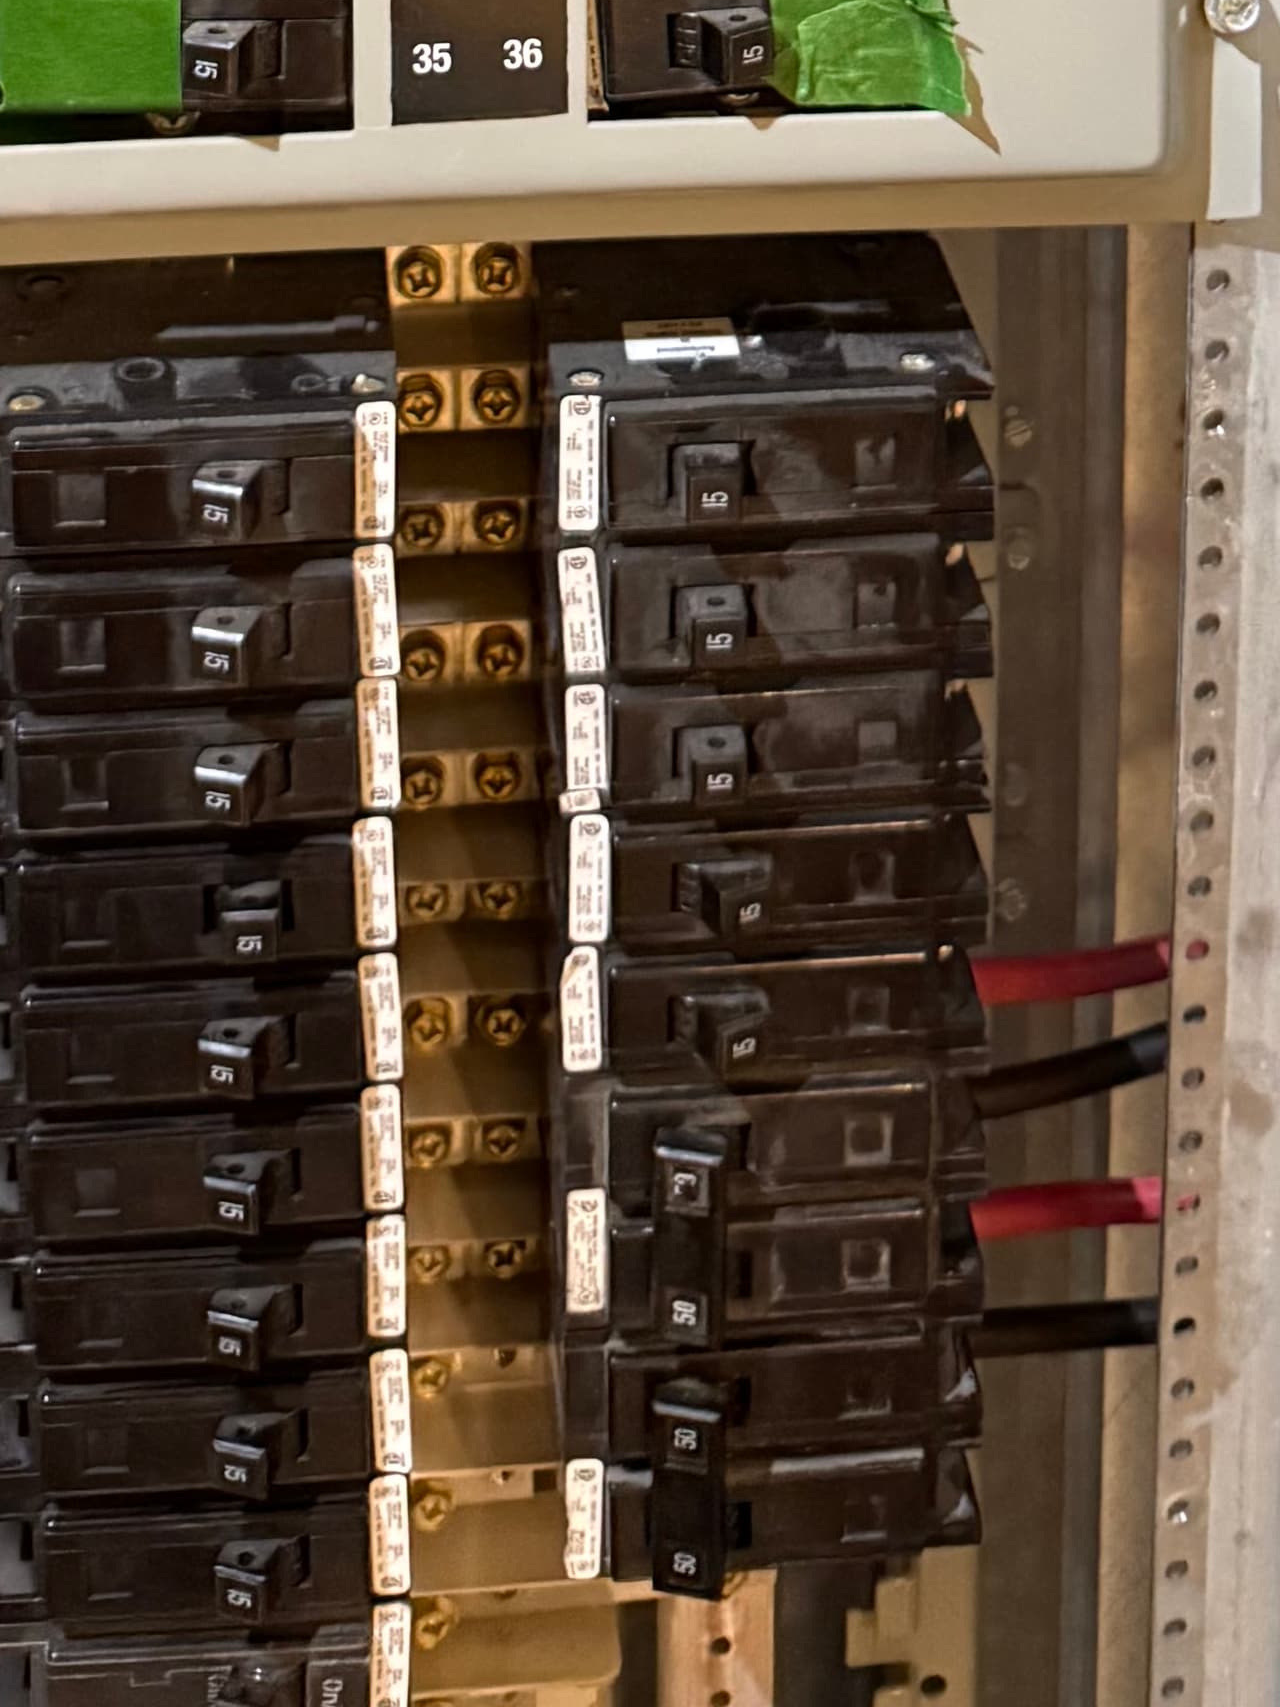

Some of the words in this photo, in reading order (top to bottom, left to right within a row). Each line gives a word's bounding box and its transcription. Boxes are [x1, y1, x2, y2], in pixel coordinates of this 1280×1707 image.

[413, 43, 451, 73] 35
[504, 39, 542, 69] 36
[702, 492, 728, 507] 15
[204, 505, 228, 523] 15
[206, 792, 230, 809] 15
[673, 1301, 696, 1325] 50
[675, 1429, 696, 1449] 50
